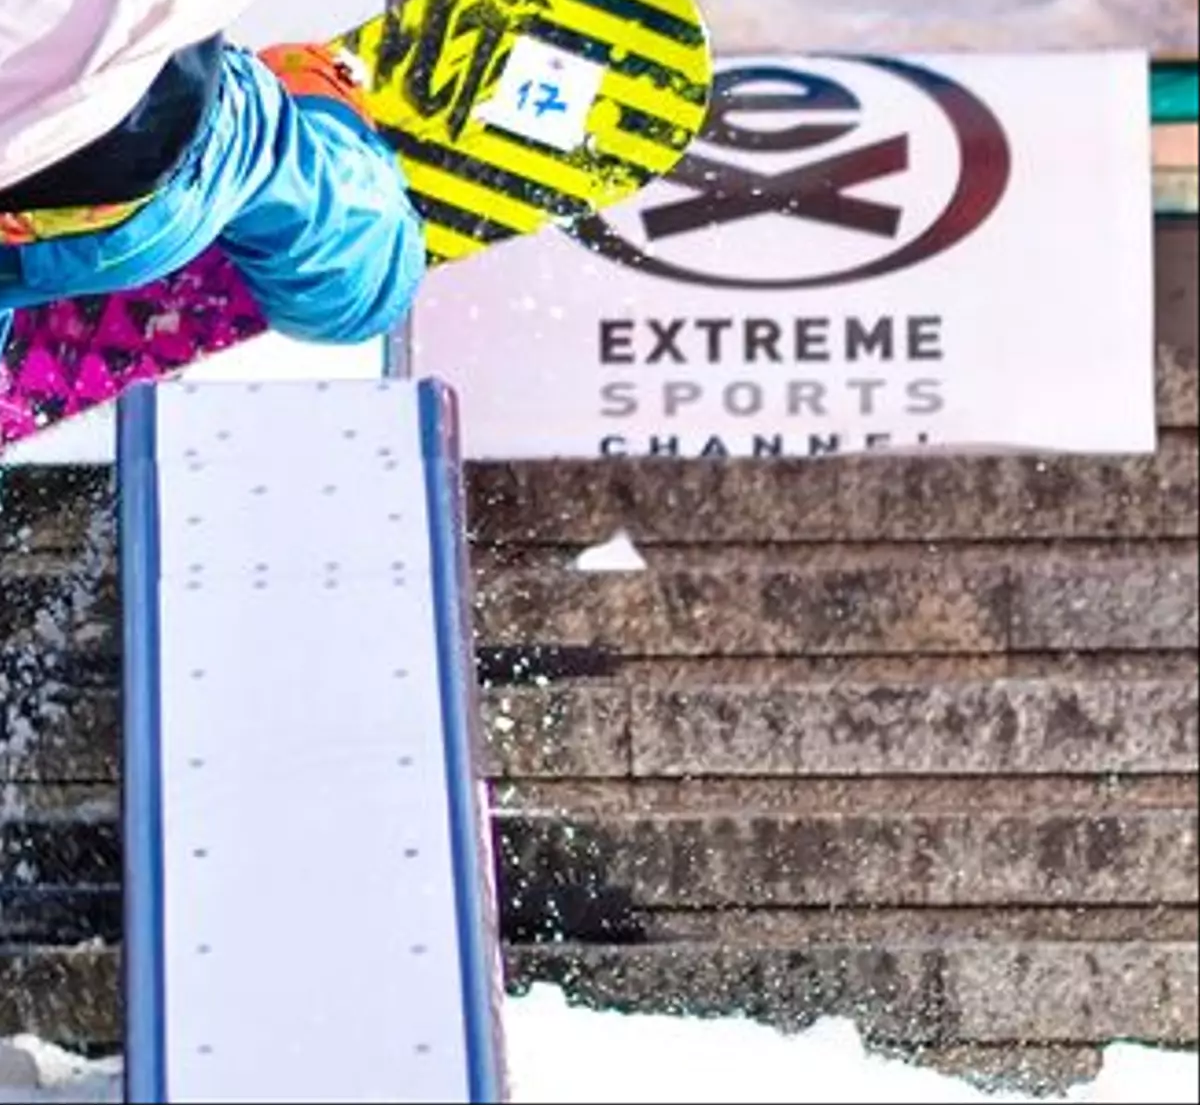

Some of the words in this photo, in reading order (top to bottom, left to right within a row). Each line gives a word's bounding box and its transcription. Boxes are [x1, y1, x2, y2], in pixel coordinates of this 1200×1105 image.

[515, 79, 569, 118] 17
[598, 315, 945, 364] EXTREME
[598, 378, 946, 418] SPORTS
